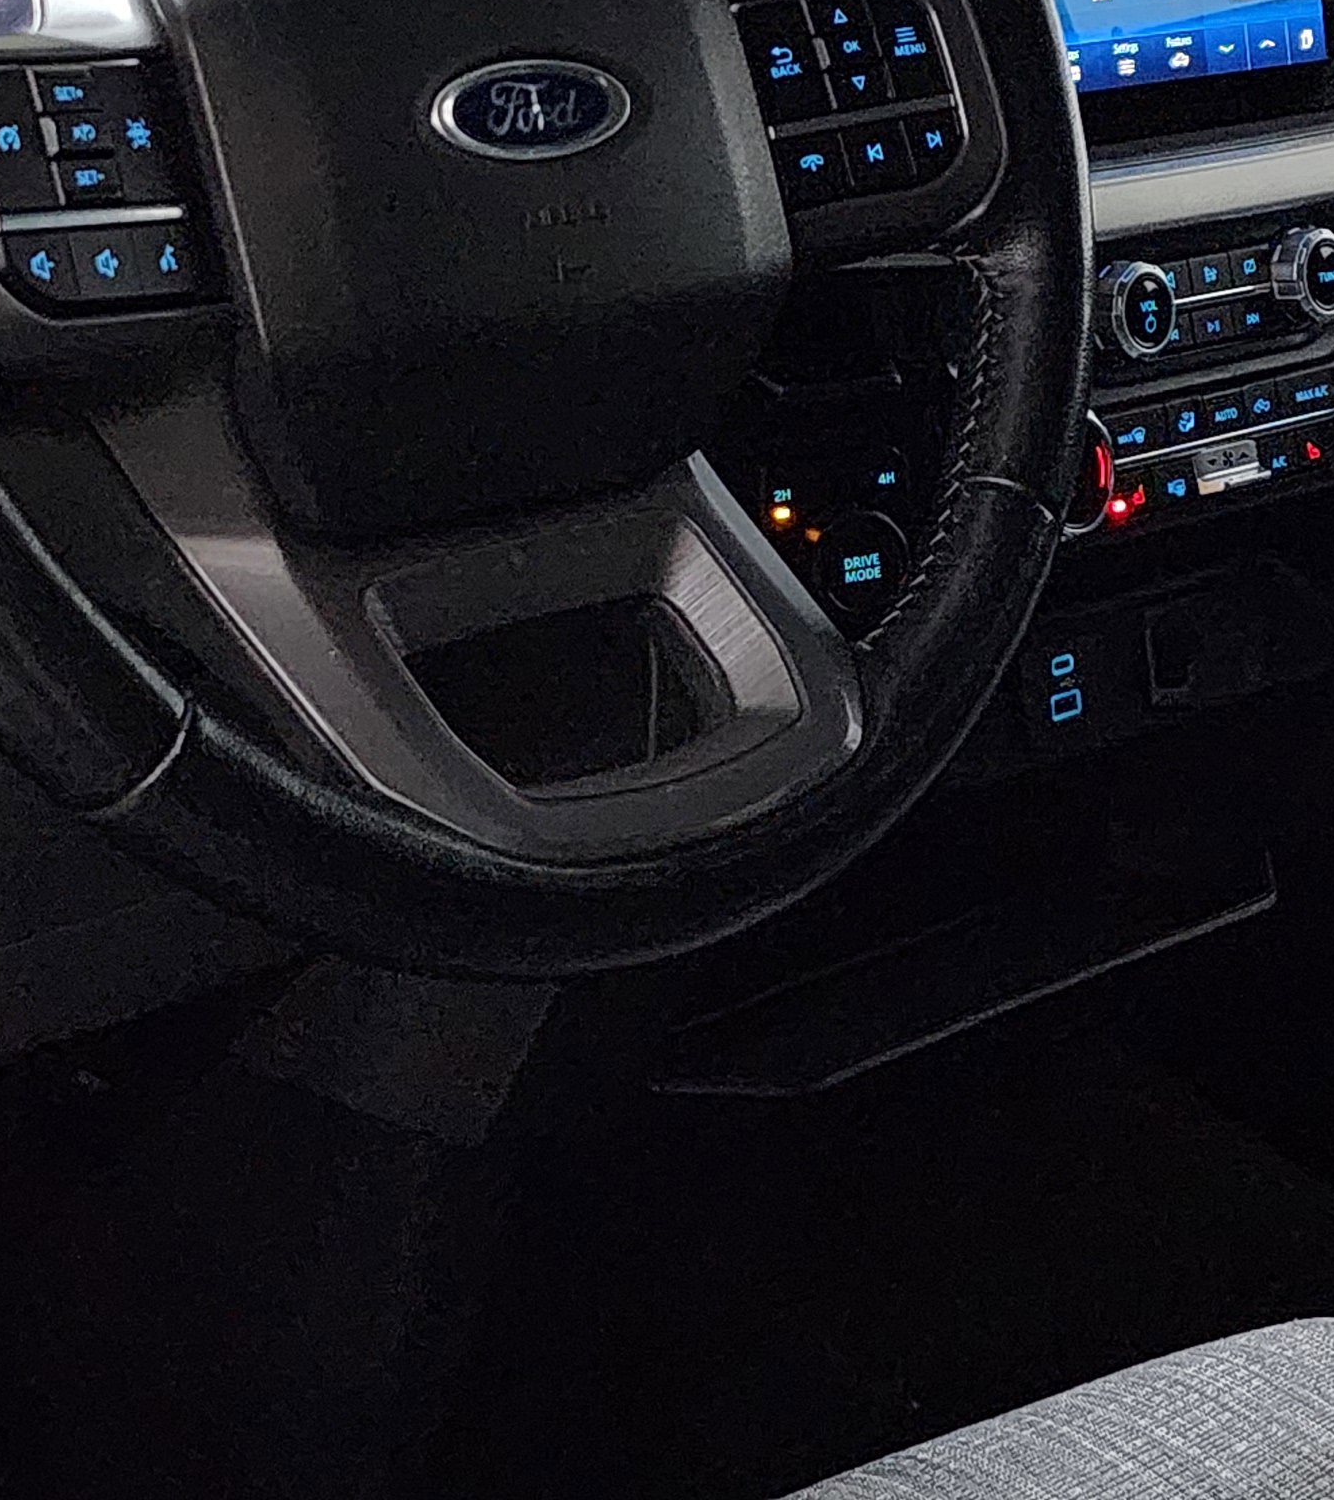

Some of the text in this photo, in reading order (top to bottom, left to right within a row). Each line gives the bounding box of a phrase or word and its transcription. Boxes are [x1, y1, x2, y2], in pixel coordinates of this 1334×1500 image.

[843, 39, 862, 53] OK
[894, 42, 927, 57] MENU
[770, 62, 803, 79] BACK
[486, 80, 580, 136] Ford
[1140, 301, 1158, 313] VOL
[1214, 407, 1238, 422] AUTO
[878, 471, 895, 485] 4H
[773, 488, 791, 502] 2H
[843, 553, 880, 571] DRIVE
[844, 566, 882, 584] MODE
